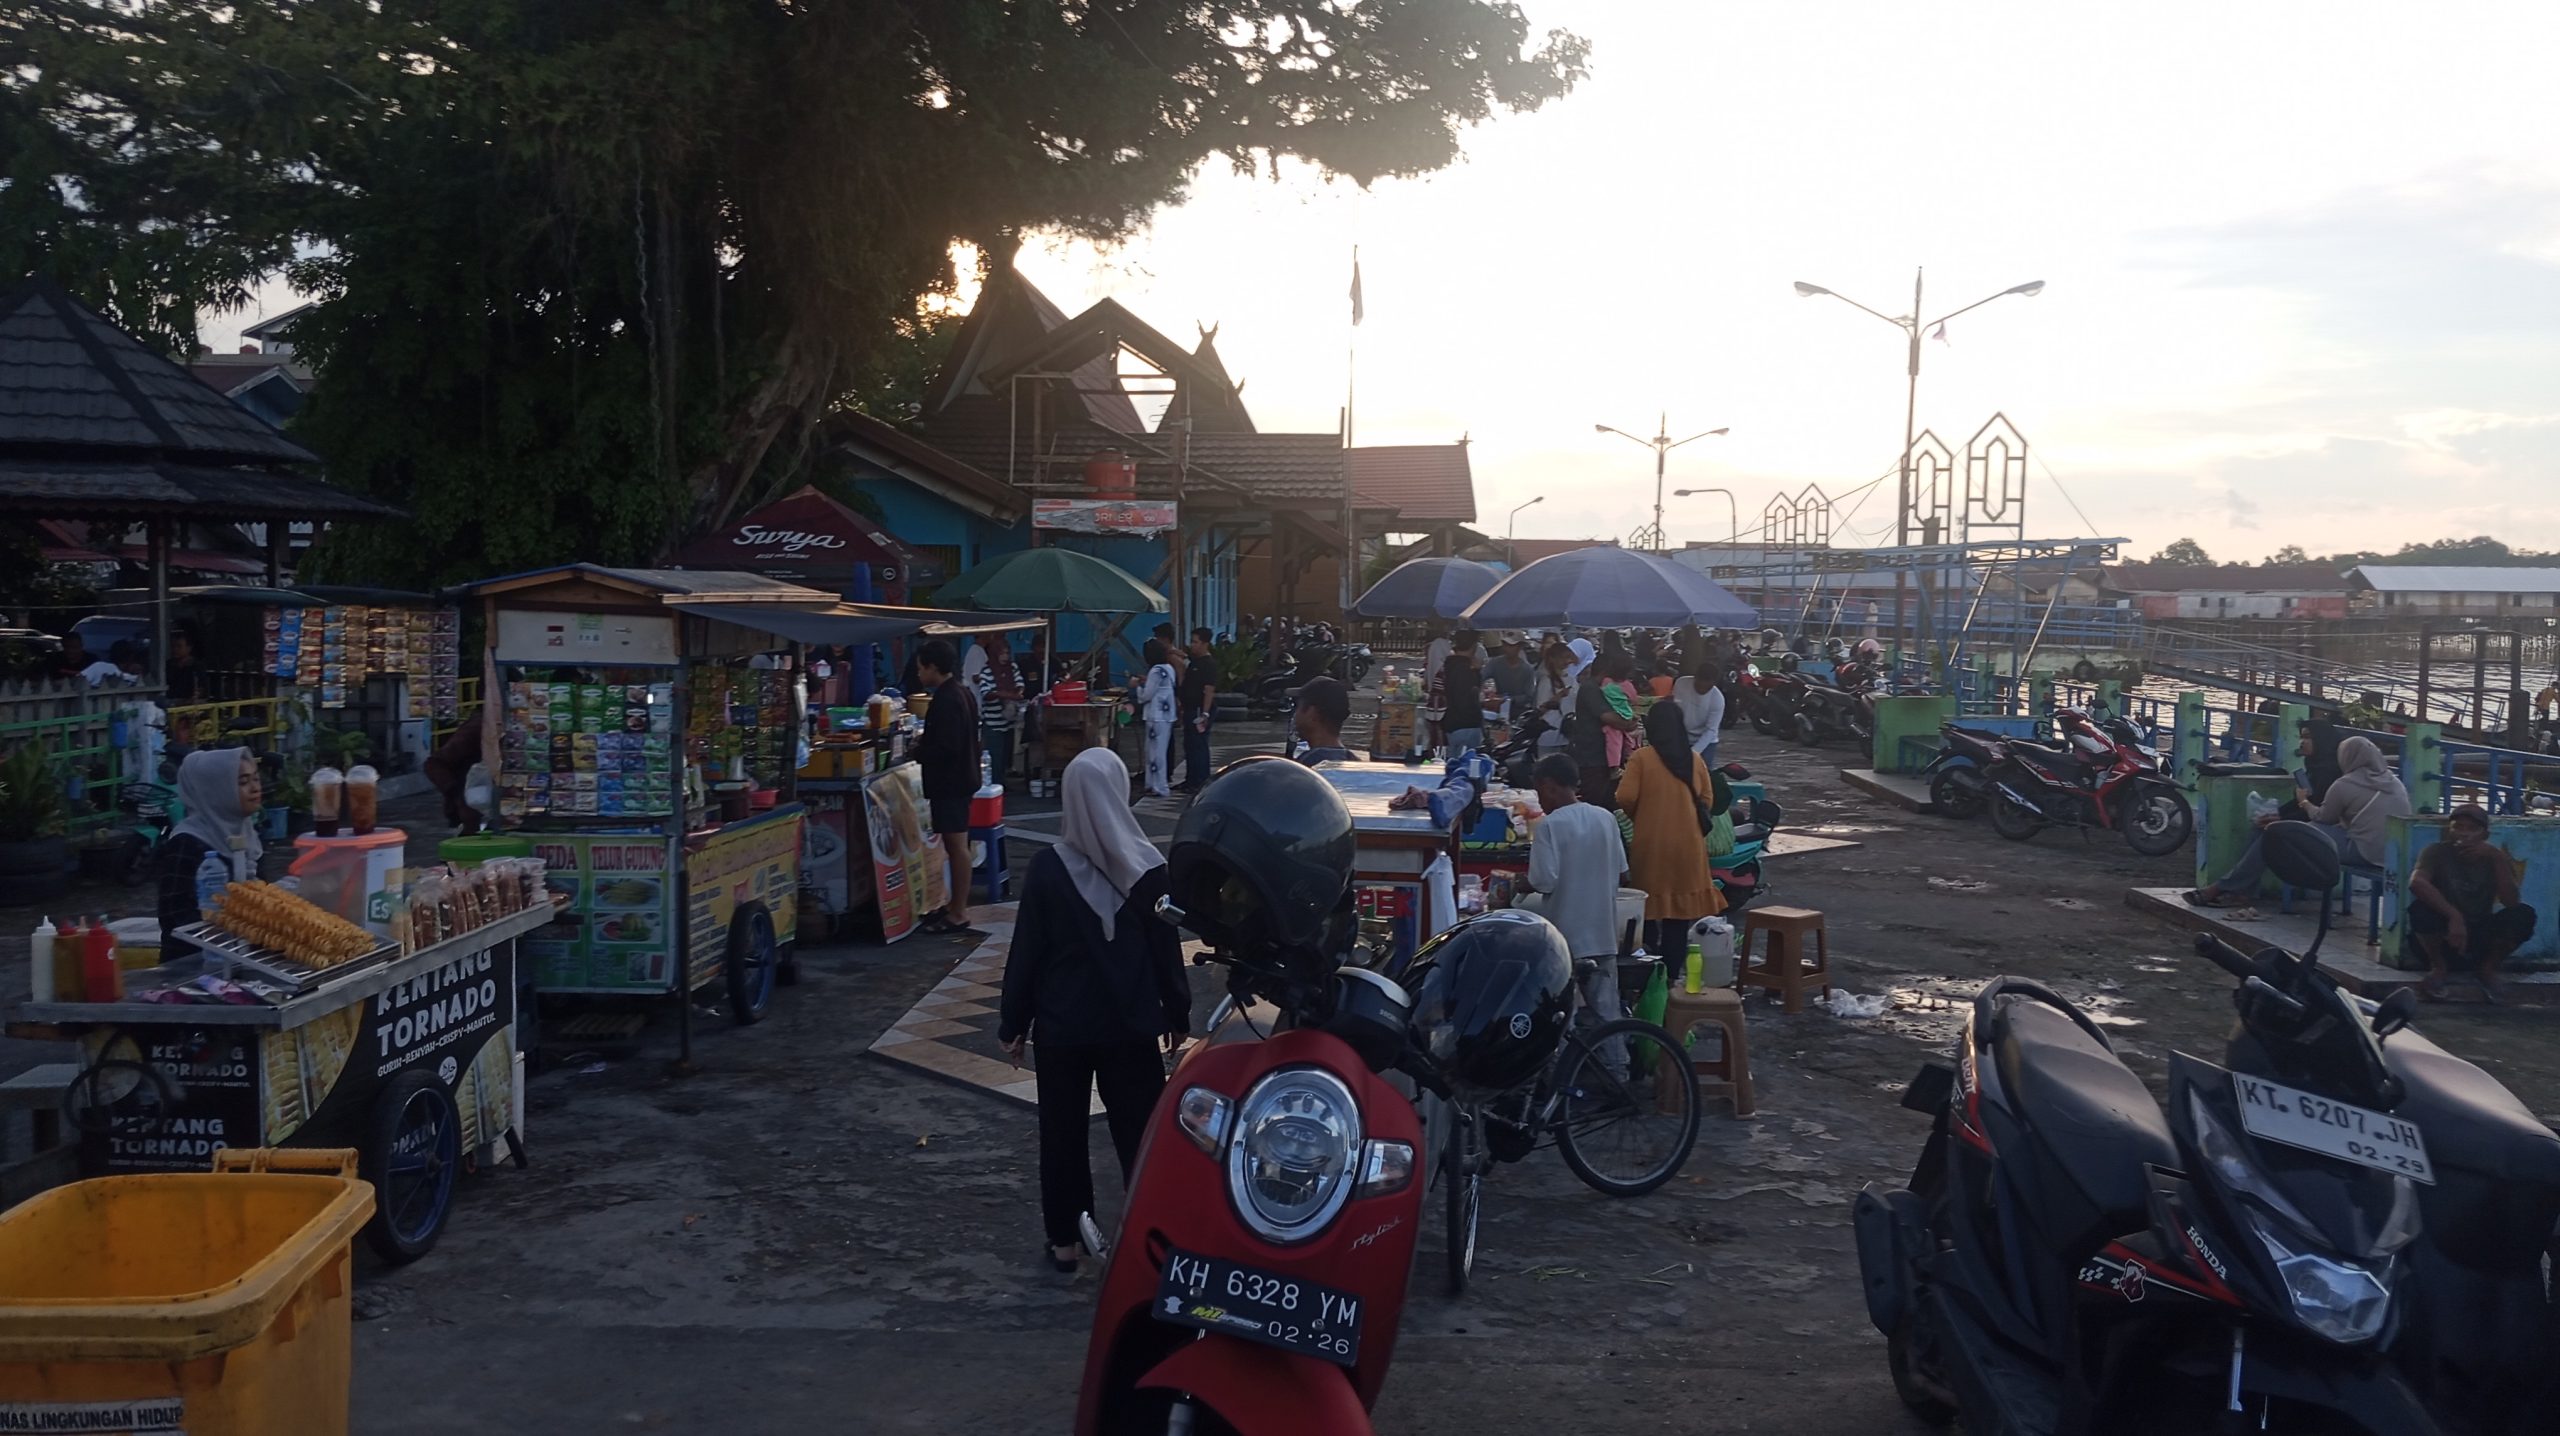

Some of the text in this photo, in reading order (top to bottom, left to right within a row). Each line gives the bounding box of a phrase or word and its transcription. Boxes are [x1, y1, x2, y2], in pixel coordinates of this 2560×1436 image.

[732, 525, 847, 551] Surya
[377, 979, 496, 1057] TORNADO
[2242, 1080, 2278, 1110] KT
[2299, 1096, 2365, 1134] 6207
[2185, 1226, 2228, 1280] HONDA
[1169, 1255, 1357, 1328] KH 6328 YM
[33, 1410, 134, 1429] LINGKUNGAN
[137, 1406, 184, 1426] HIDUP
